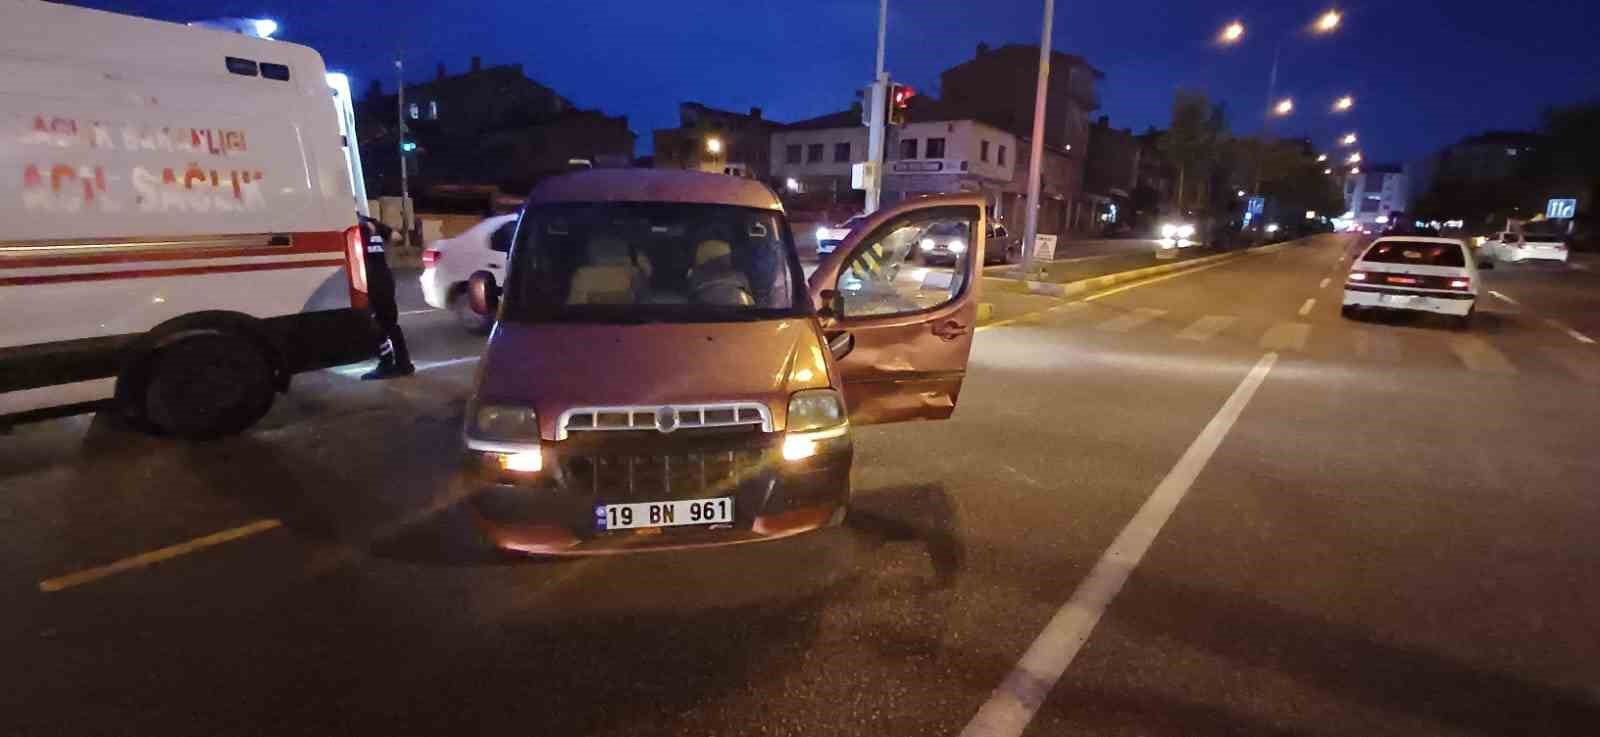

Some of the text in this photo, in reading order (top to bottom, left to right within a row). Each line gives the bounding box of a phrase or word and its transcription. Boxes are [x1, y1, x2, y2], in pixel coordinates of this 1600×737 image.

[609, 501, 725, 526] 19 BN 961
